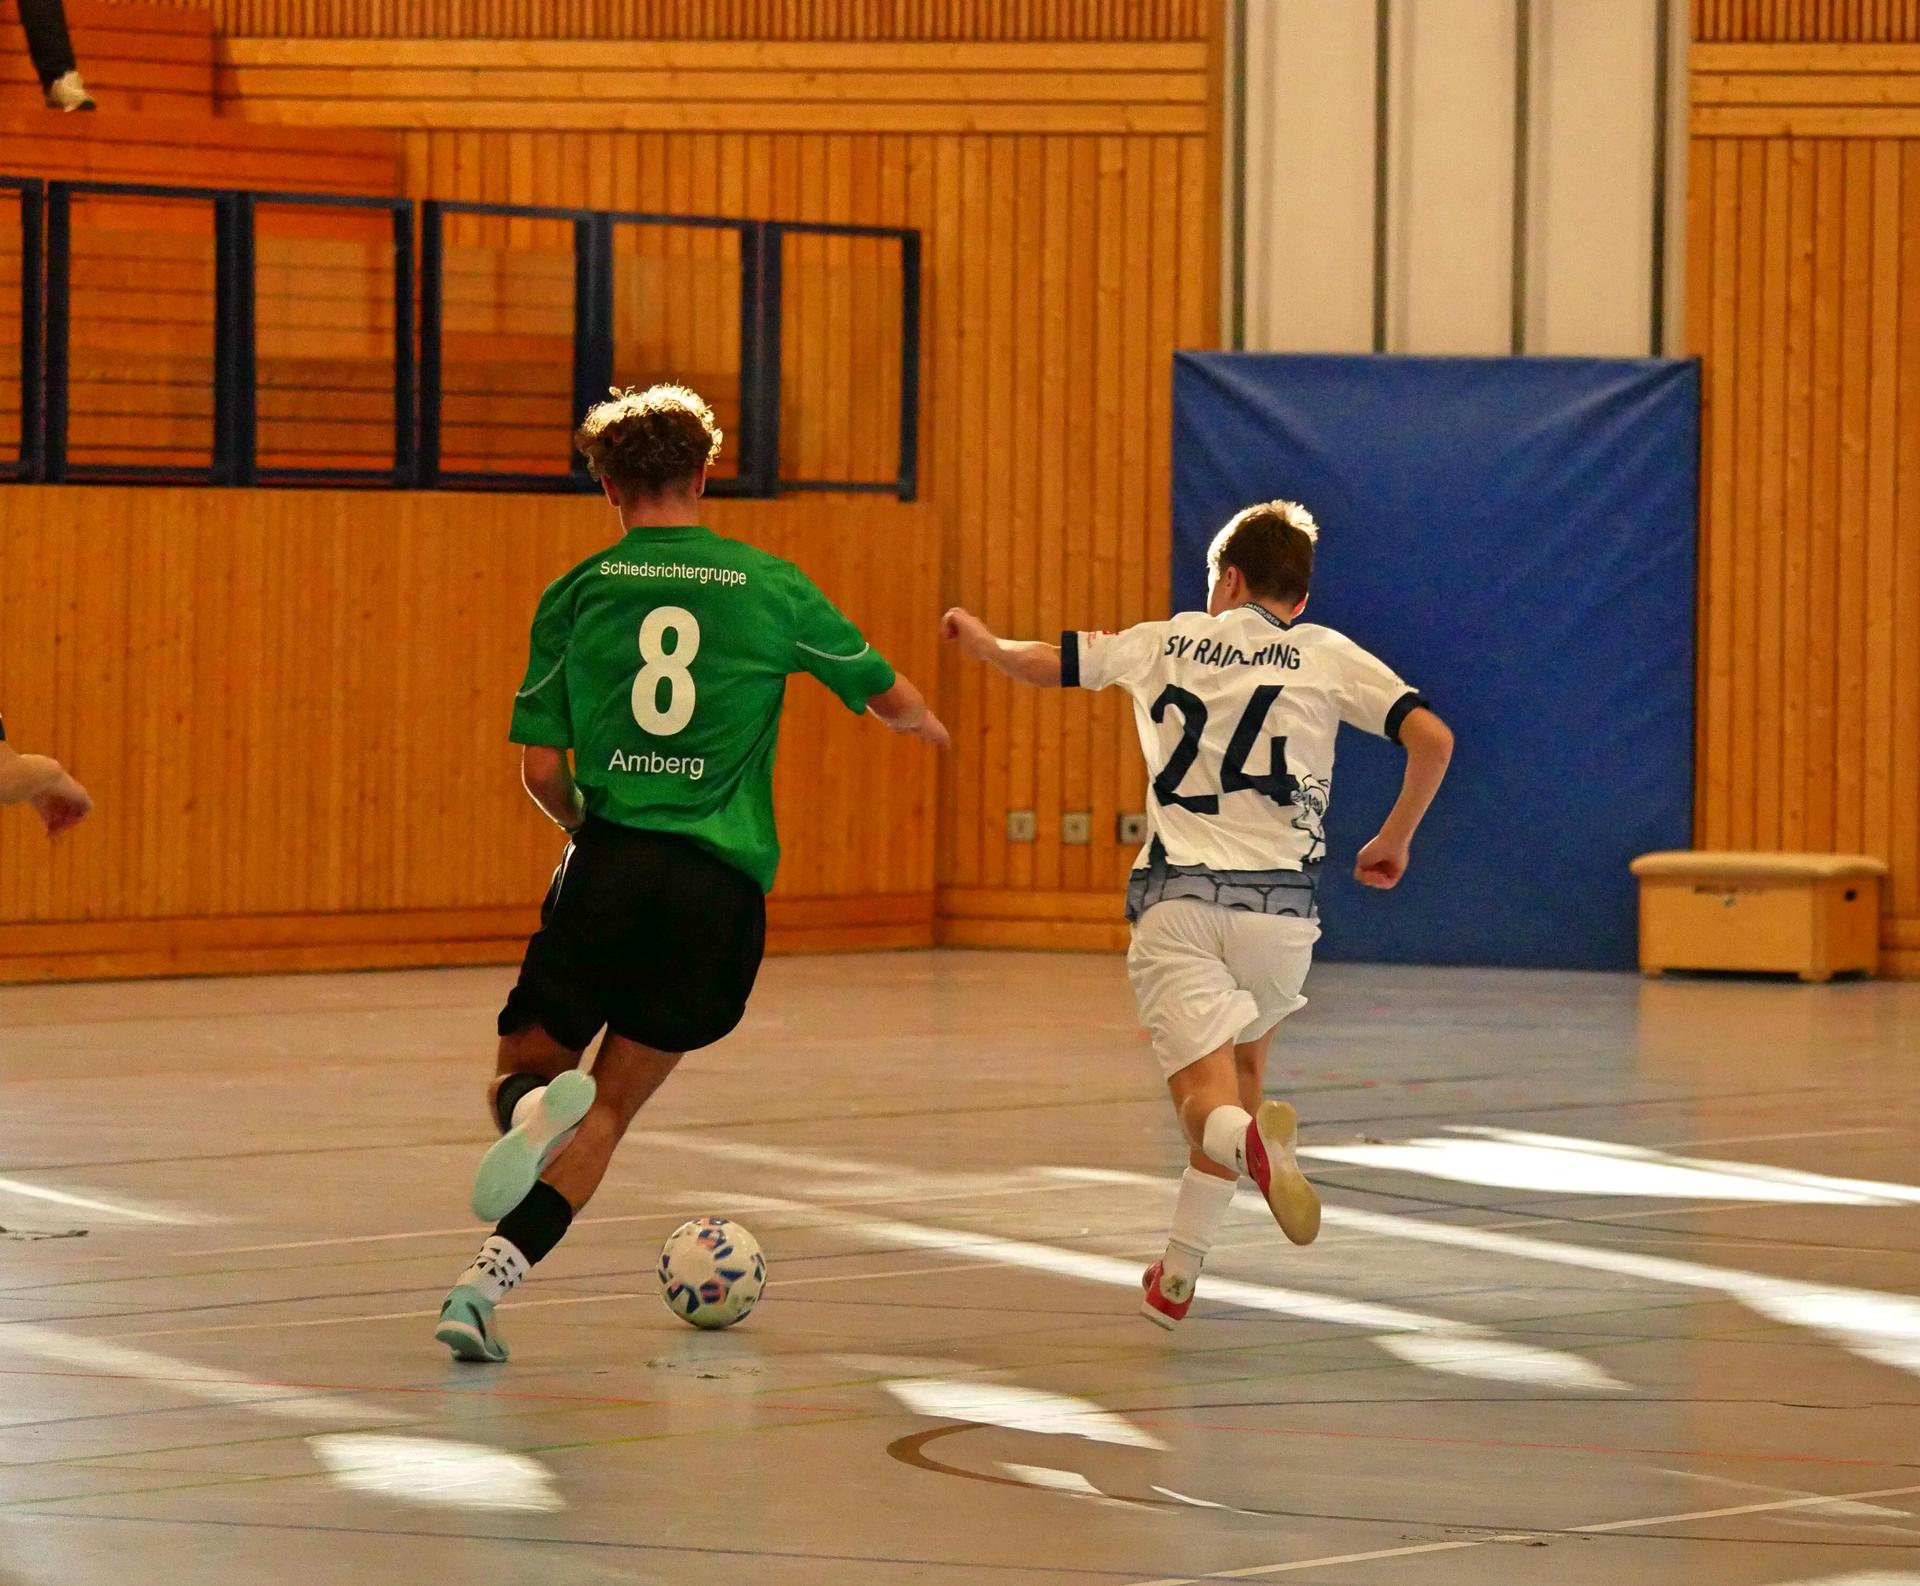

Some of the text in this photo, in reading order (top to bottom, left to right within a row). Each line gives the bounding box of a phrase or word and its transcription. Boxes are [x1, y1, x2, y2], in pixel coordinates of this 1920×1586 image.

[600, 561, 747, 586] Schiedsrichtergruppe
[1164, 635, 1300, 670] SV RAIRING
[631, 605, 700, 736] 8
[608, 749, 704, 780] Amberg
[1151, 683, 1300, 815] 24
